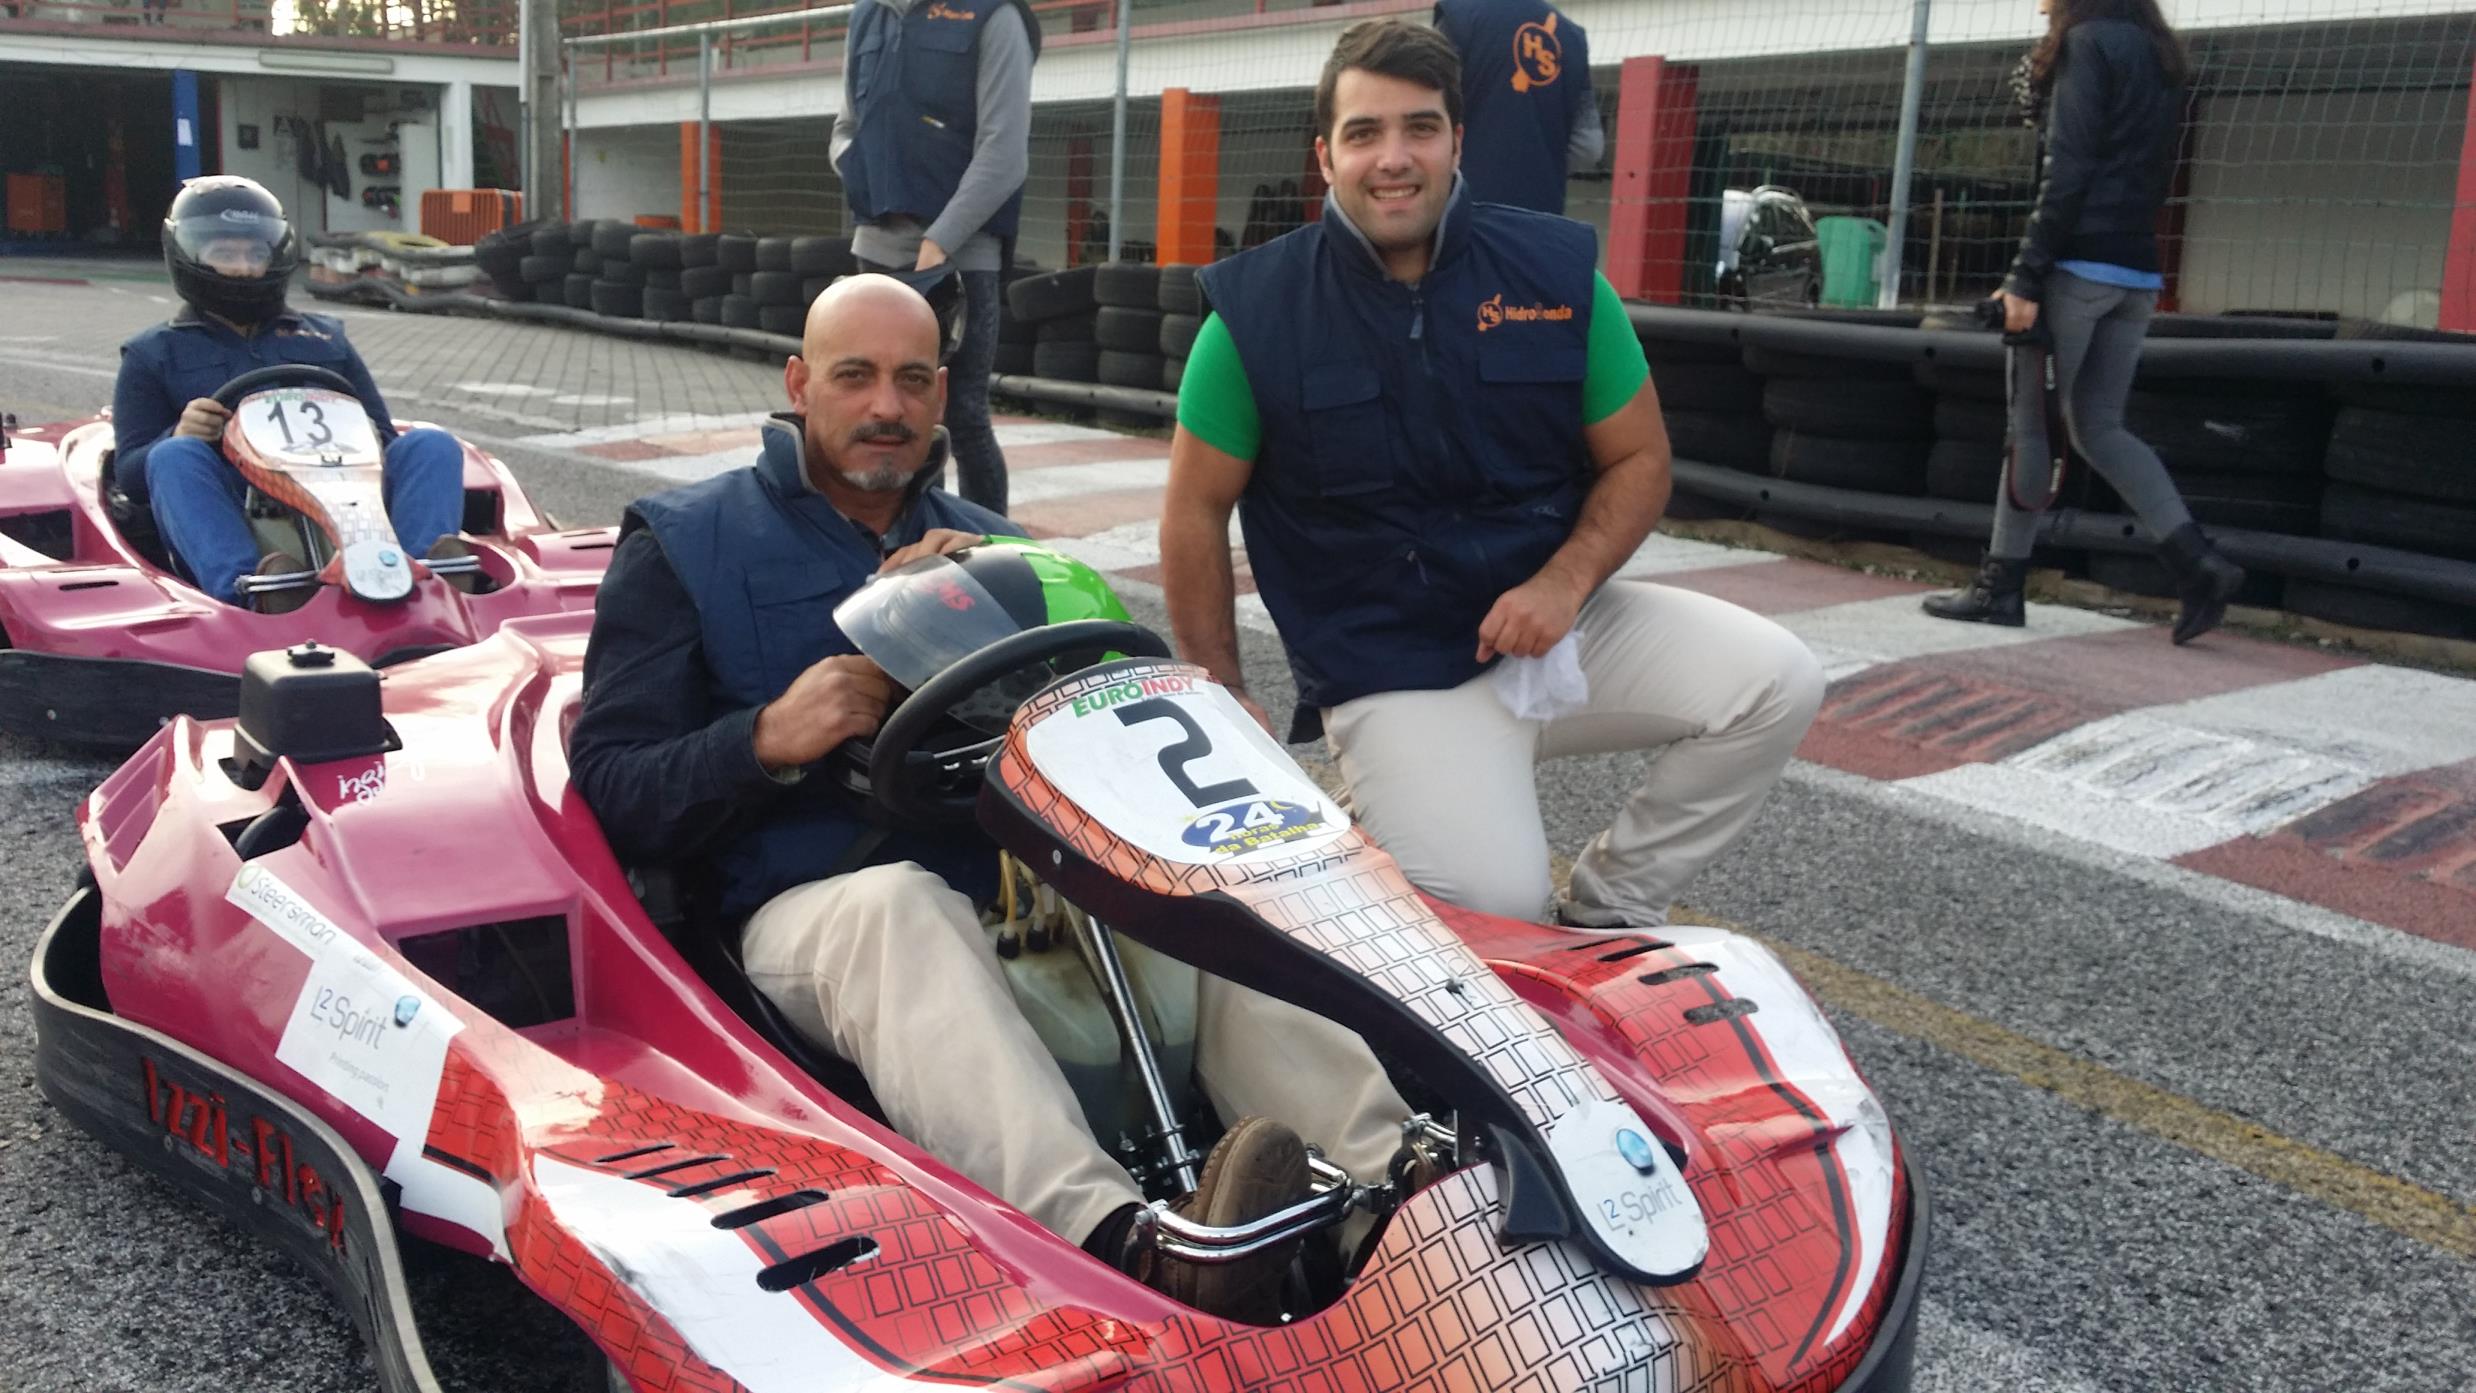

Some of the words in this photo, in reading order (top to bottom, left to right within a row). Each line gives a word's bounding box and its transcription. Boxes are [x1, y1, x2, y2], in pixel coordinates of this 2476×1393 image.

[267, 401, 333, 448] 13
[1071, 674, 1194, 719] EUROINDY
[1112, 697, 1261, 809] 2
[1194, 800, 1286, 843] 24
[1214, 842, 1243, 856] da
[1243, 821, 1322, 847] Batalha
[328, 995, 389, 1051] Spirit
[1619, 1178, 1683, 1225] Spirit
